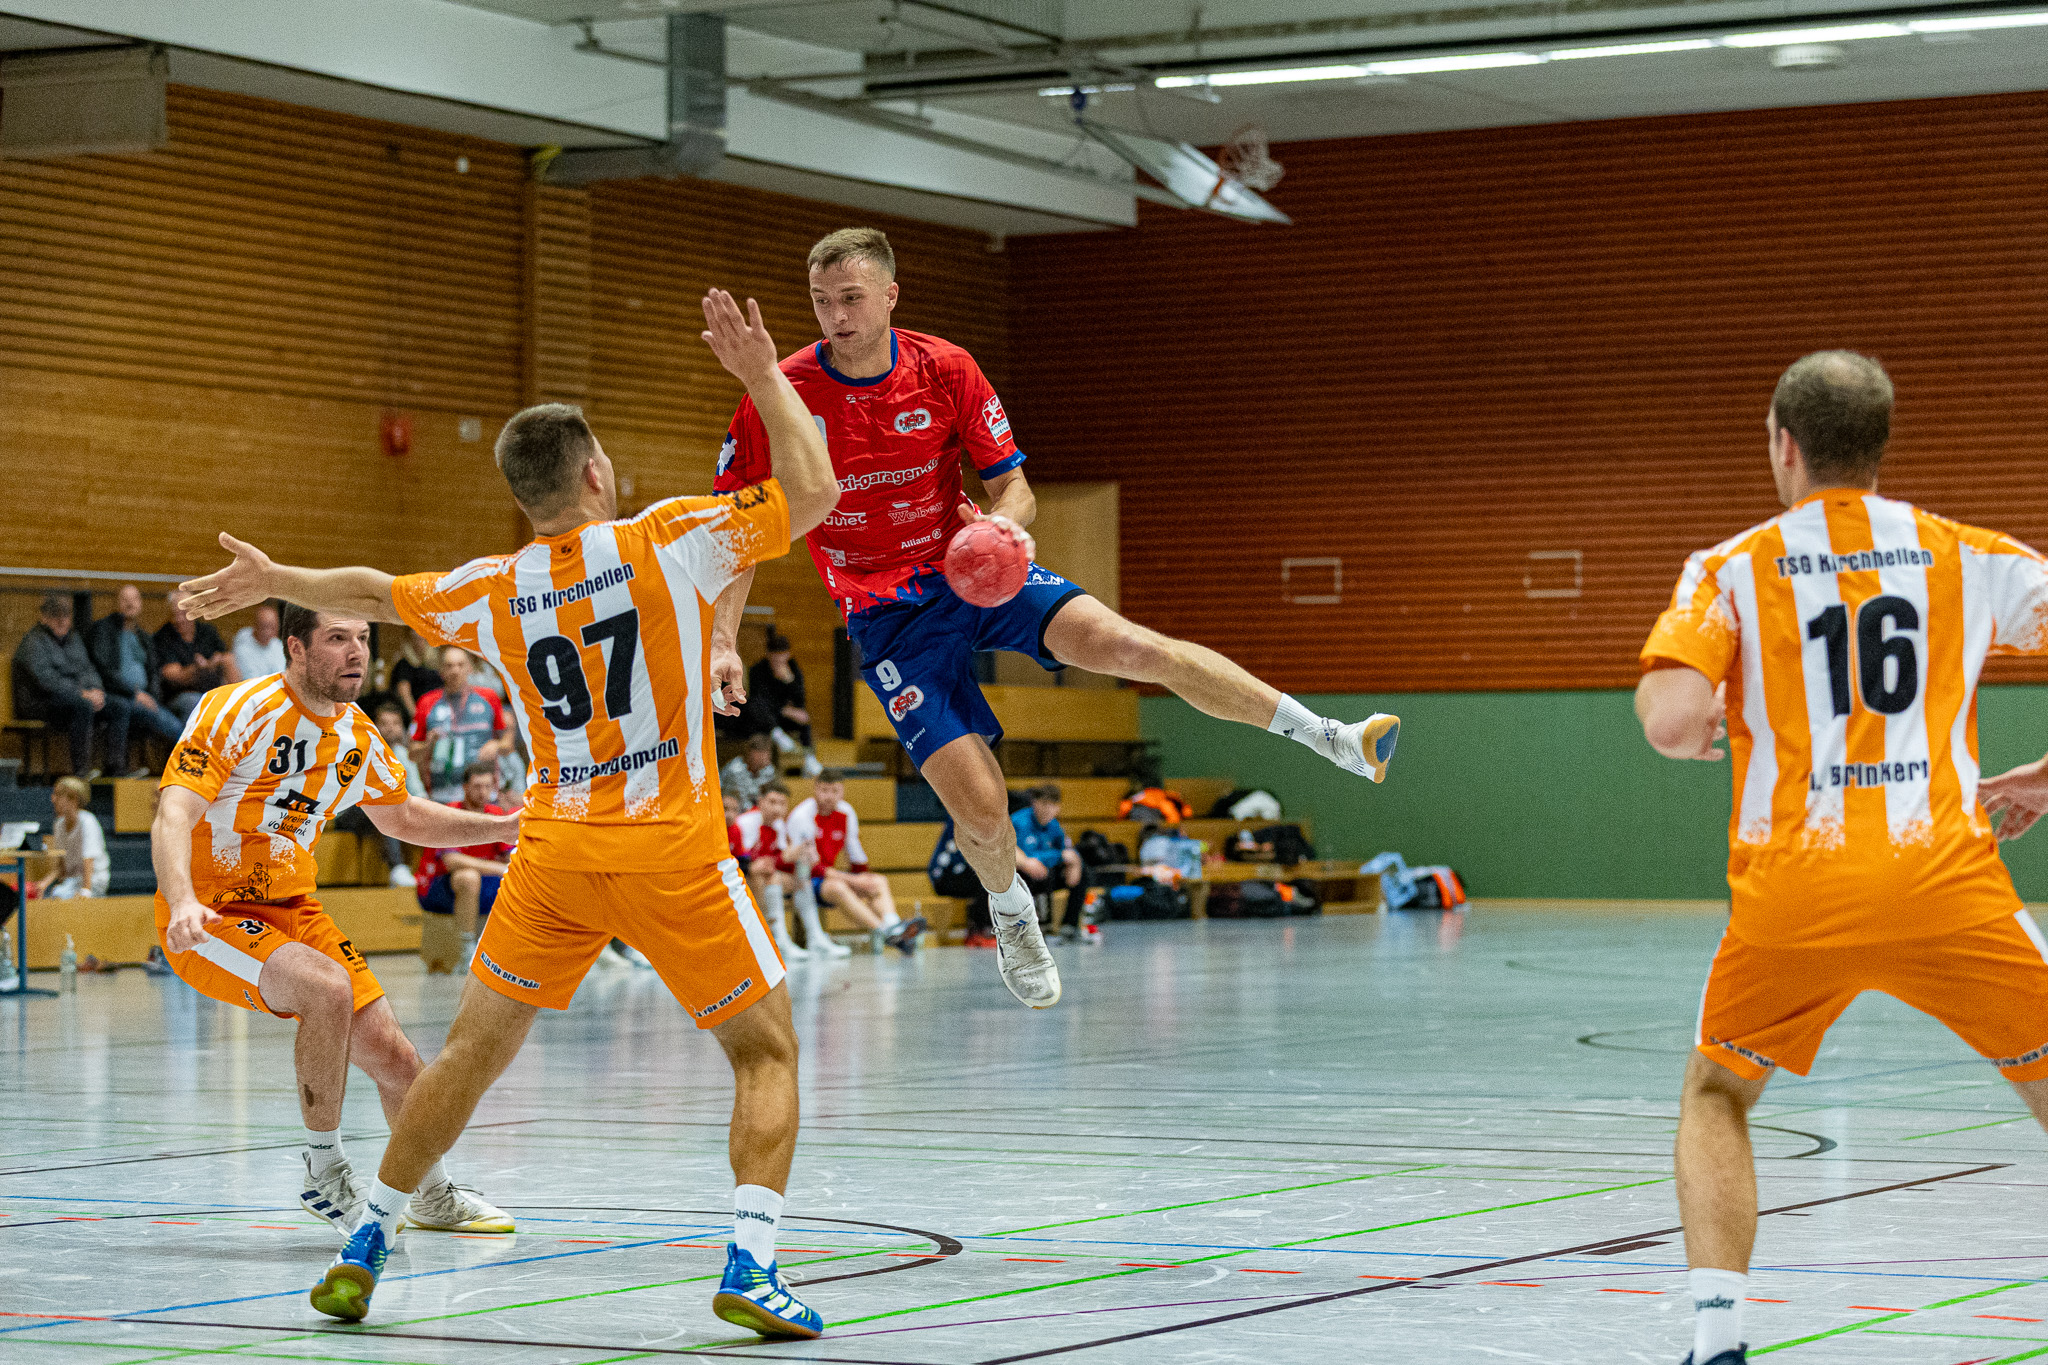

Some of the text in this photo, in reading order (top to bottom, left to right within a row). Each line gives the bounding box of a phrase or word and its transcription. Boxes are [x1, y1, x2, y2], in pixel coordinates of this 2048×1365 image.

[837, 457, 938, 492] xi-garagen.de
[888, 501, 943, 523] Weber
[901, 534, 932, 549] Allianz
[1775, 548, 1934, 577] TSG Kirchhellen
[508, 562, 635, 617] TSG Kirchhellen
[526, 607, 640, 731] 97
[1806, 594, 1919, 719] 16
[875, 660, 902, 691] 9
[268, 735, 309, 775] 31
[502, 971, 518, 983] DEN
[732, 977, 753, 998] CLUB!
